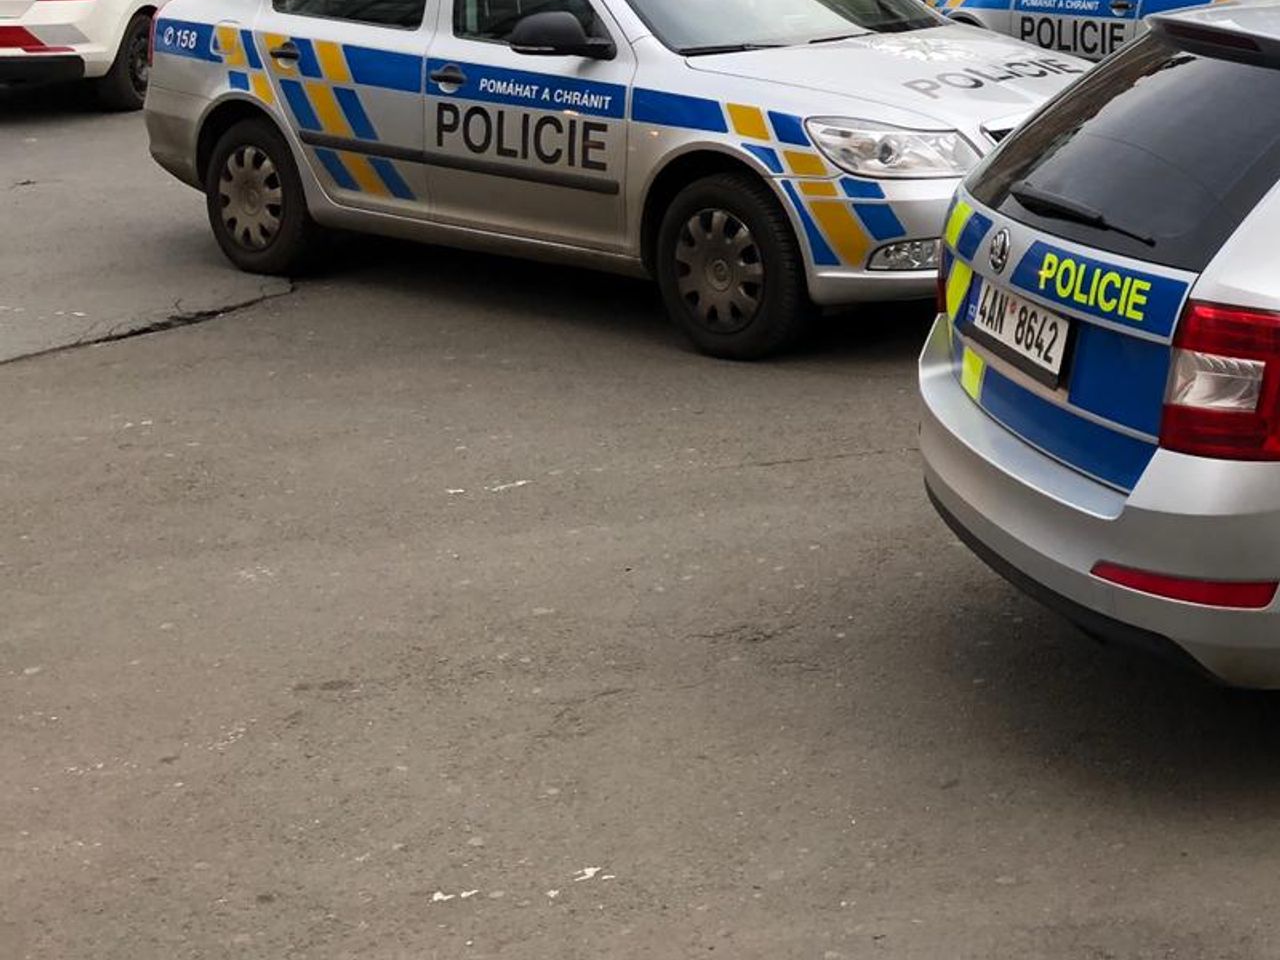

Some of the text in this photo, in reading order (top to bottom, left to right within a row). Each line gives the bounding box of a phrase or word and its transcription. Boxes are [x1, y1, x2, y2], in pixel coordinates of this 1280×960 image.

[176, 28, 198, 49] 158
[1020, 16, 1126, 54] POLICIE
[479, 77, 612, 110] POMÁHAT A CHRÁNIT
[903, 59, 1084, 100] POLICIE
[437, 102, 609, 172] POLICIE
[1038, 252, 1152, 322] POLICIE
[978, 285, 1059, 364] 4AN 8642
